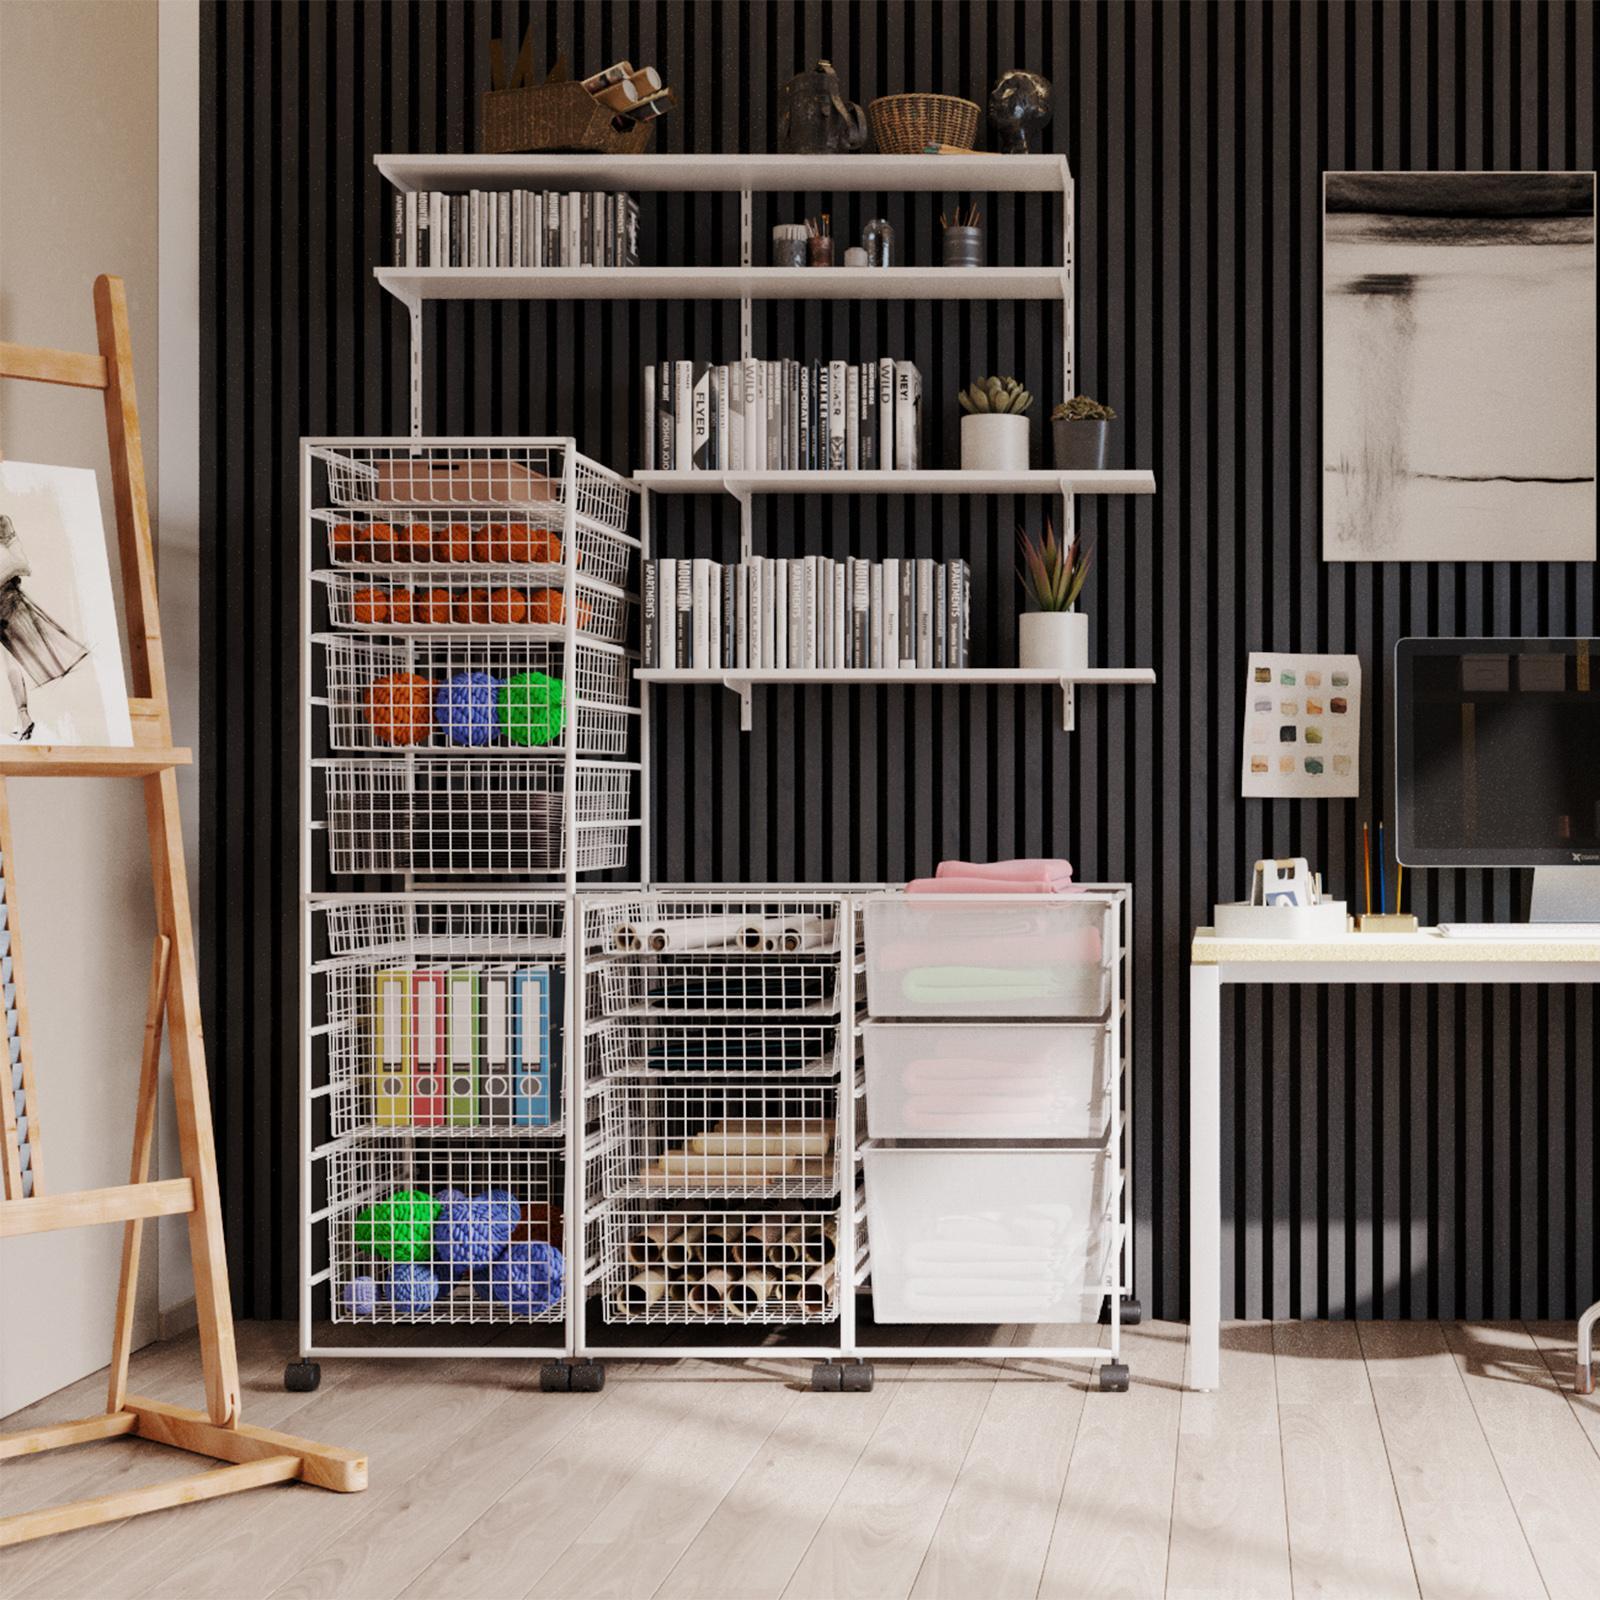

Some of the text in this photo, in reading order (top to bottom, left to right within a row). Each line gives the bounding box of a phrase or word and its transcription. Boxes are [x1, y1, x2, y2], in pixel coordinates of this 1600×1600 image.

[745, 364, 755, 404] WILD
[800, 366, 808, 429] CORPORATE
[819, 367, 828, 418] SUMMER
[880, 364, 890, 404] WILD
[899, 374, 908, 401] HEY!
[695, 392, 705, 436] FLYER
[645, 563, 655, 619] APARTMENTS
[677, 559, 690, 612] MOUNTAIN
[855, 559, 869, 612] MOUNTAIN
[951, 561, 961, 618] APARTMENTS
